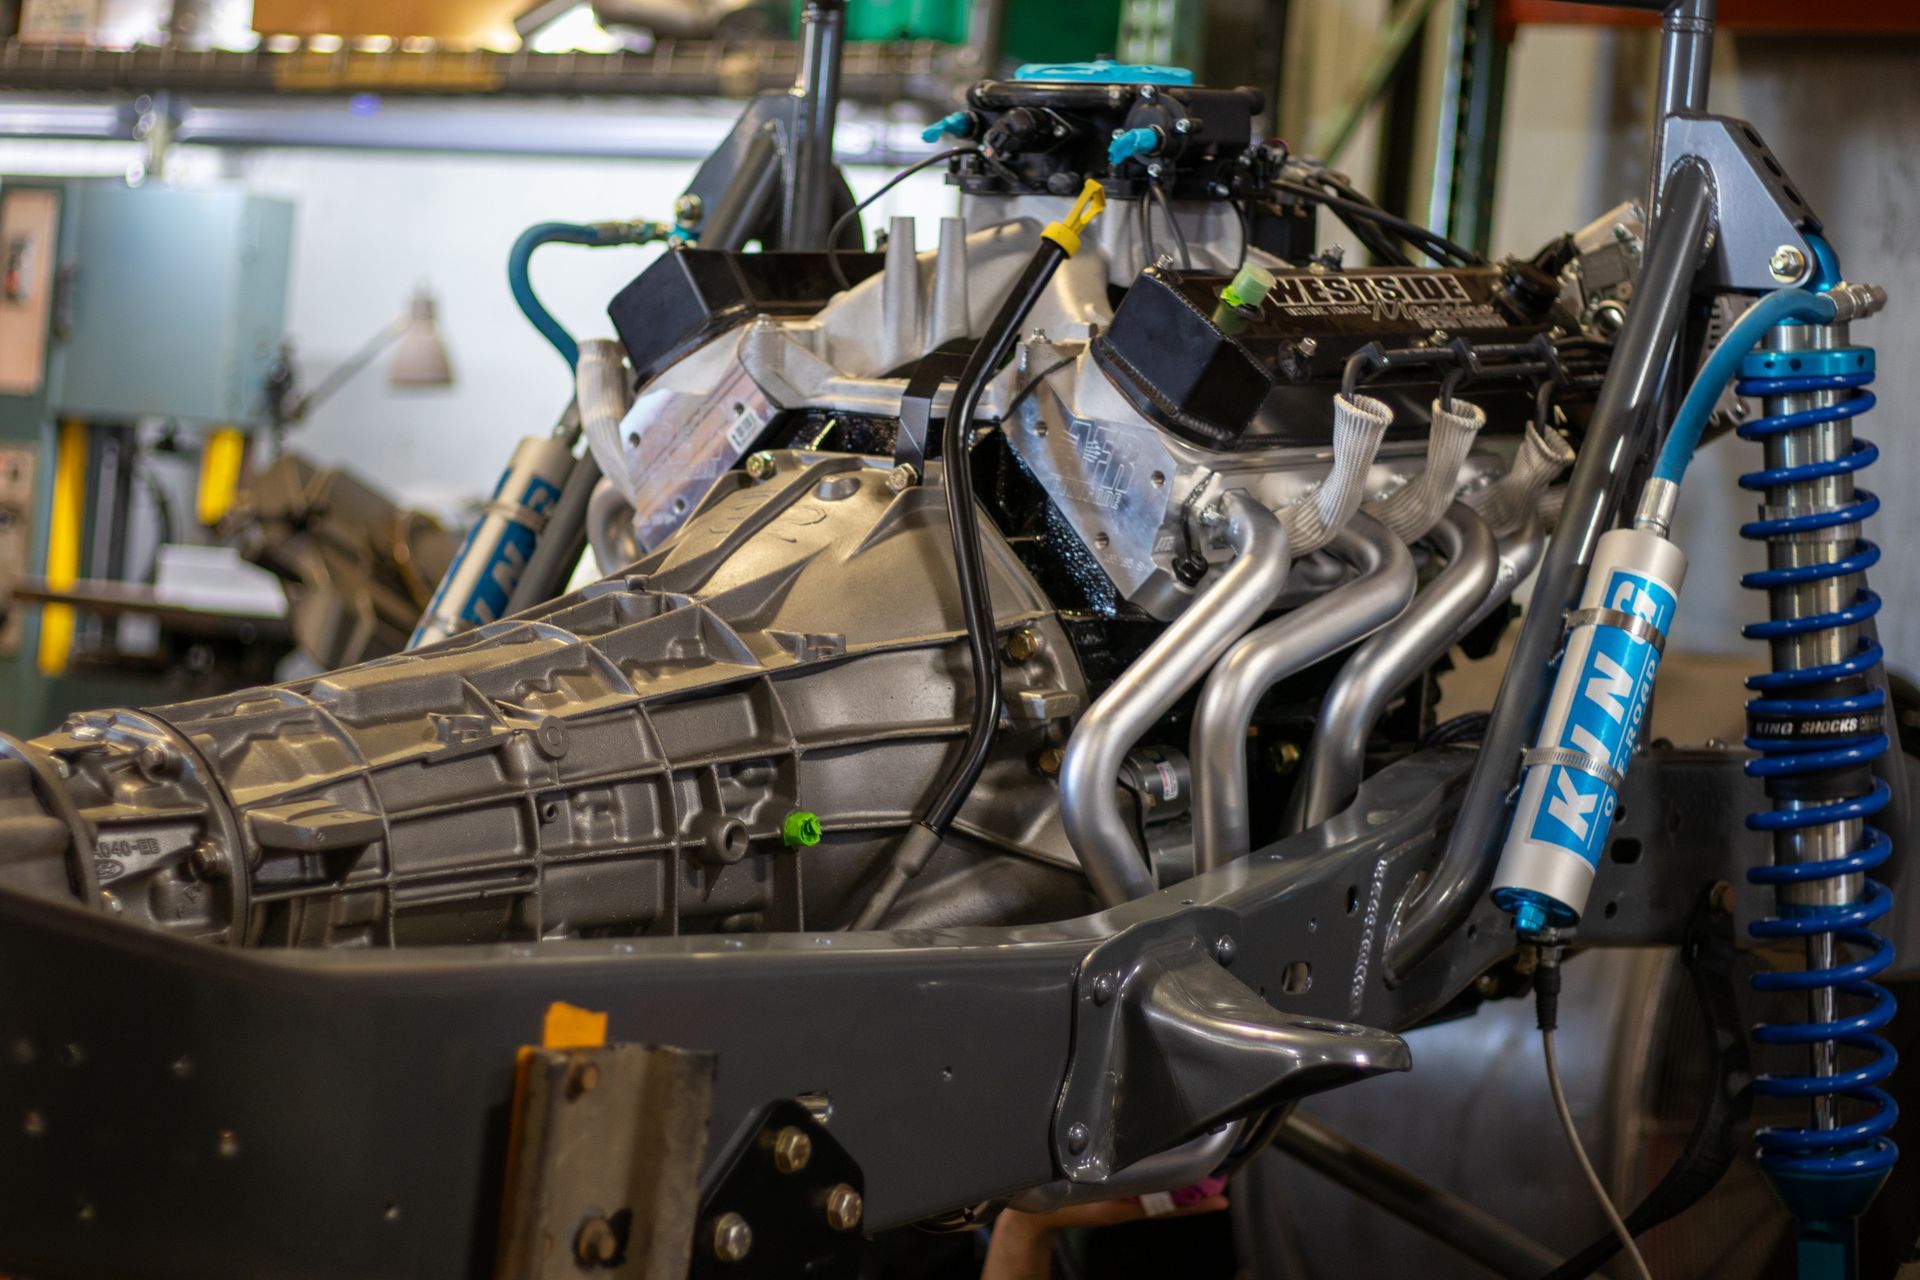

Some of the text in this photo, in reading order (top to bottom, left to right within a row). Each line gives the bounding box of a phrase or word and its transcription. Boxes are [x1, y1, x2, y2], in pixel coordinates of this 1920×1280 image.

[1266, 274, 1471, 306] WESTSIDE
[1548, 580, 1657, 842] KING
[1604, 659, 1656, 817] OF-ROAD
[1756, 722, 1794, 735] KING
[1800, 717, 1858, 735] SHOCKS
